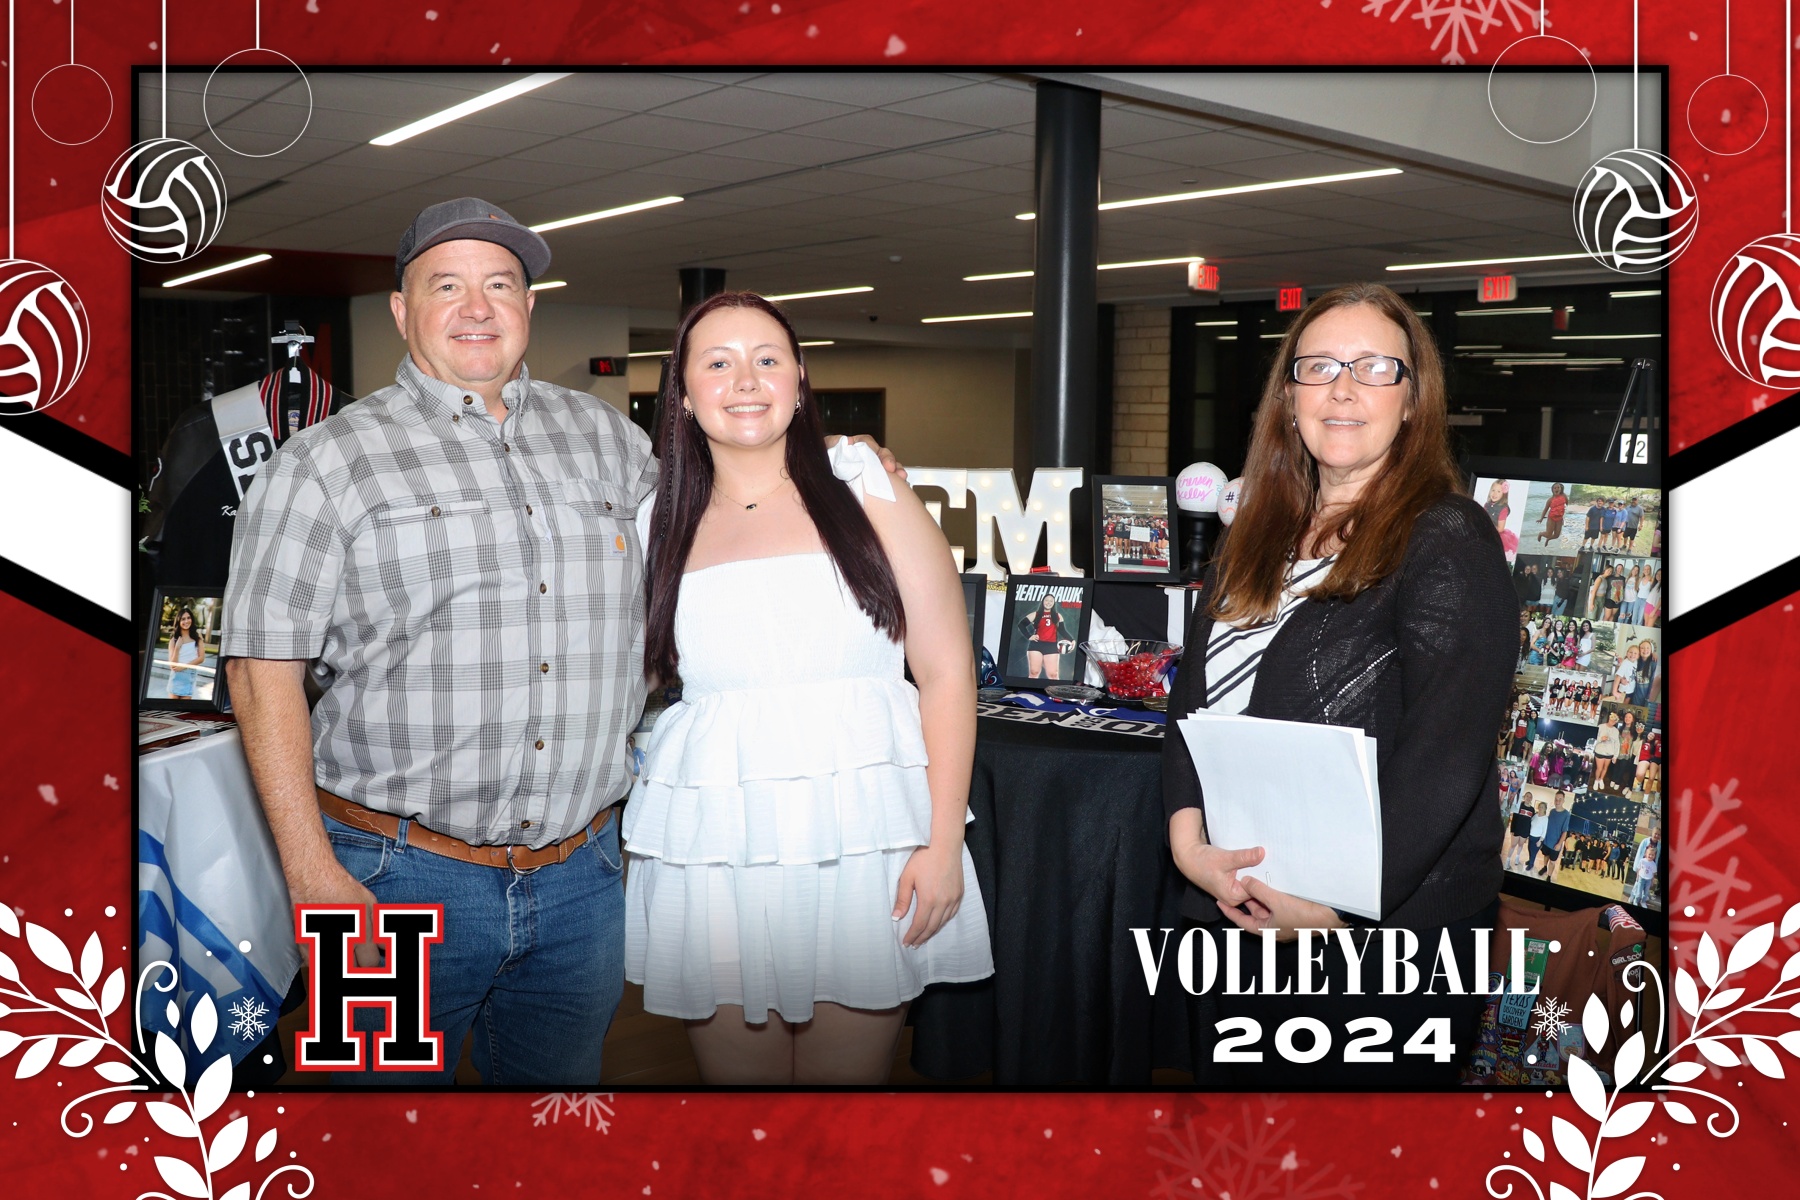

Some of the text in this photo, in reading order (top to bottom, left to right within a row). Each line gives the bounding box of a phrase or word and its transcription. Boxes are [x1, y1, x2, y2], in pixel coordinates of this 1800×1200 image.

[1198, 264, 1218, 290] EXIT
[1483, 275, 1511, 301] EXIT
[1280, 288, 1302, 311] EXIT
[1015, 584, 1048, 601] HEATH
[1612, 956, 1627, 965] GIRL
[1505, 994, 1531, 1008] TEXAS
[1503, 1005, 1526, 1017] DISCOVERY
[1502, 1014, 1524, 1027] GARDENS
